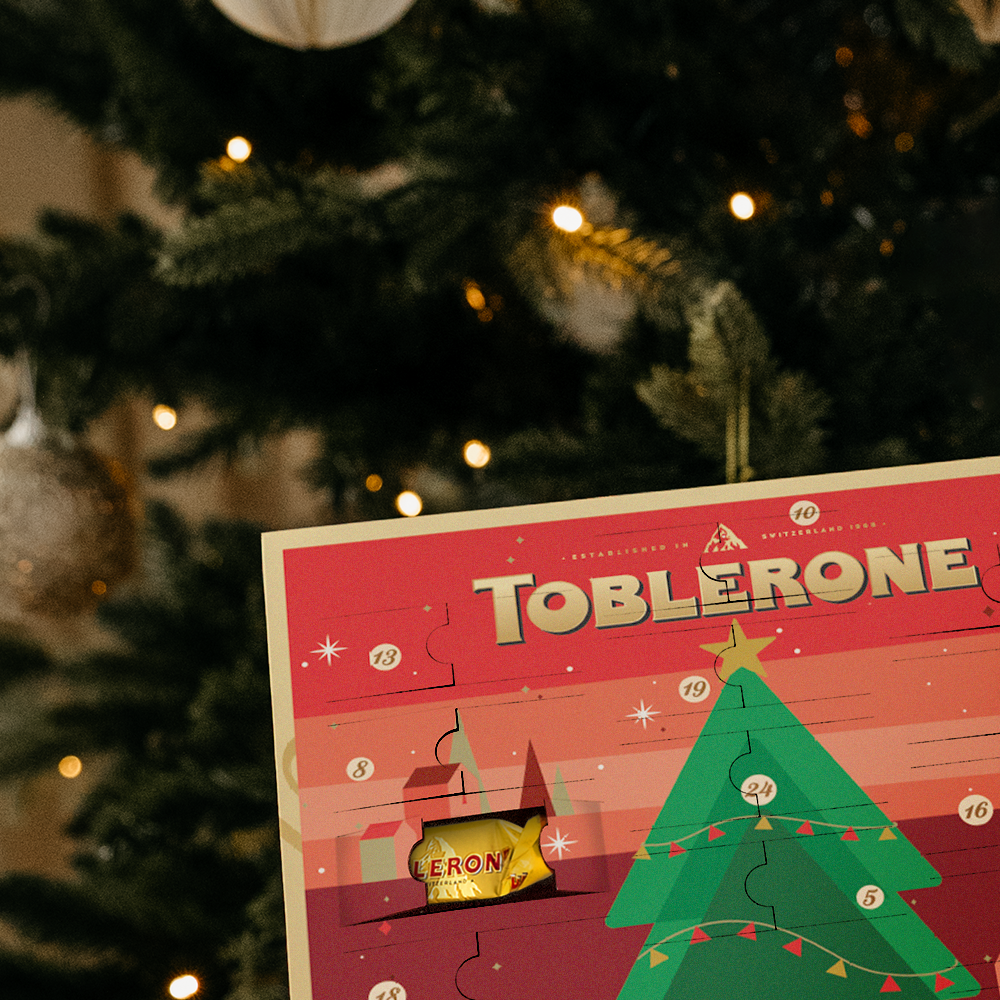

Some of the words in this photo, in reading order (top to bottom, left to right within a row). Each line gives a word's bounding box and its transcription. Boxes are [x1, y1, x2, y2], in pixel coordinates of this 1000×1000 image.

[793, 505, 816, 521] 10
[761, 525, 843, 540] SWITZERLAND
[572, 544, 666, 561] ESTABLISHED
[675, 541, 689, 549] IN
[472, 536, 982, 647] TOBLERONE
[371, 649, 398, 667] 13
[682, 680, 707, 698] 19
[352, 760, 368, 779] 8
[745, 780, 774, 798] 24
[964, 802, 988, 820] 16
[863, 888, 879, 908] 5
